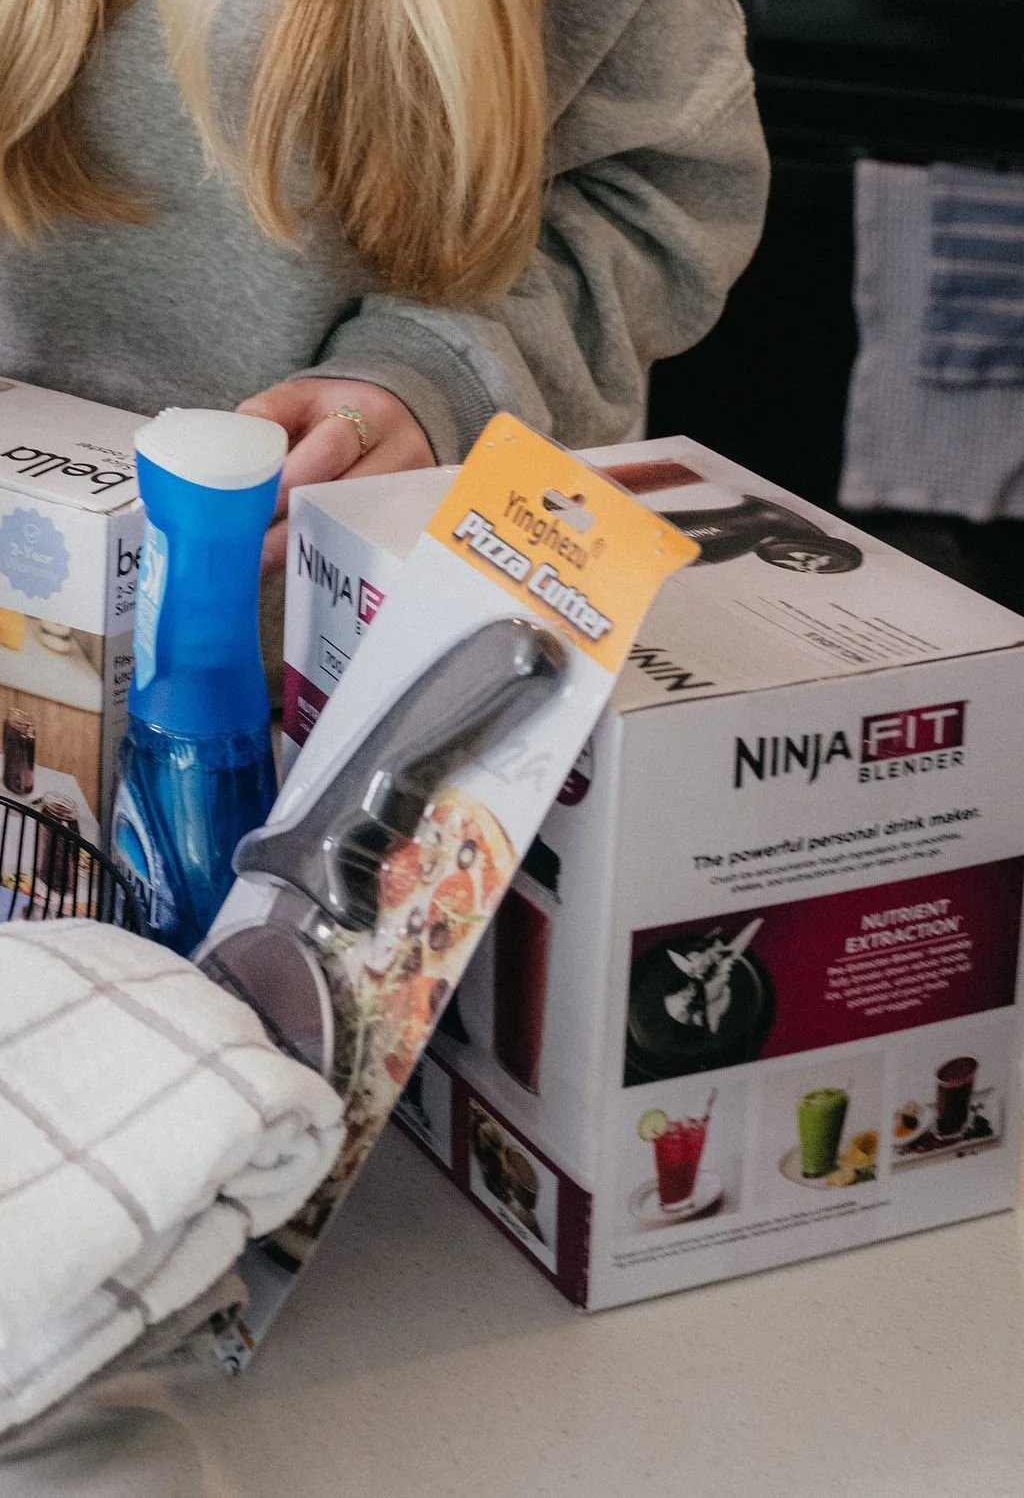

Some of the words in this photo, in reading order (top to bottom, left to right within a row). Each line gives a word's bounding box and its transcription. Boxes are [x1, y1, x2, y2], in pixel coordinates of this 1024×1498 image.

[296, 532, 354, 608] NINJA
[451, 508, 532, 583] Pizza
[527, 562, 613, 642] Cutter
[627, 643, 717, 693] NINJ
[734, 730, 852, 789] NINJA
[867, 707, 960, 758] FIT
[858, 750, 965, 784] BLENDER
[692, 853, 724, 871] The
[728, 836, 806, 867] powerful
[806, 823, 881, 853] personal
[883, 815, 926, 836] drink
[844, 914, 961, 954] EXTRACTION
[861, 897, 952, 931] NUTRIENT
